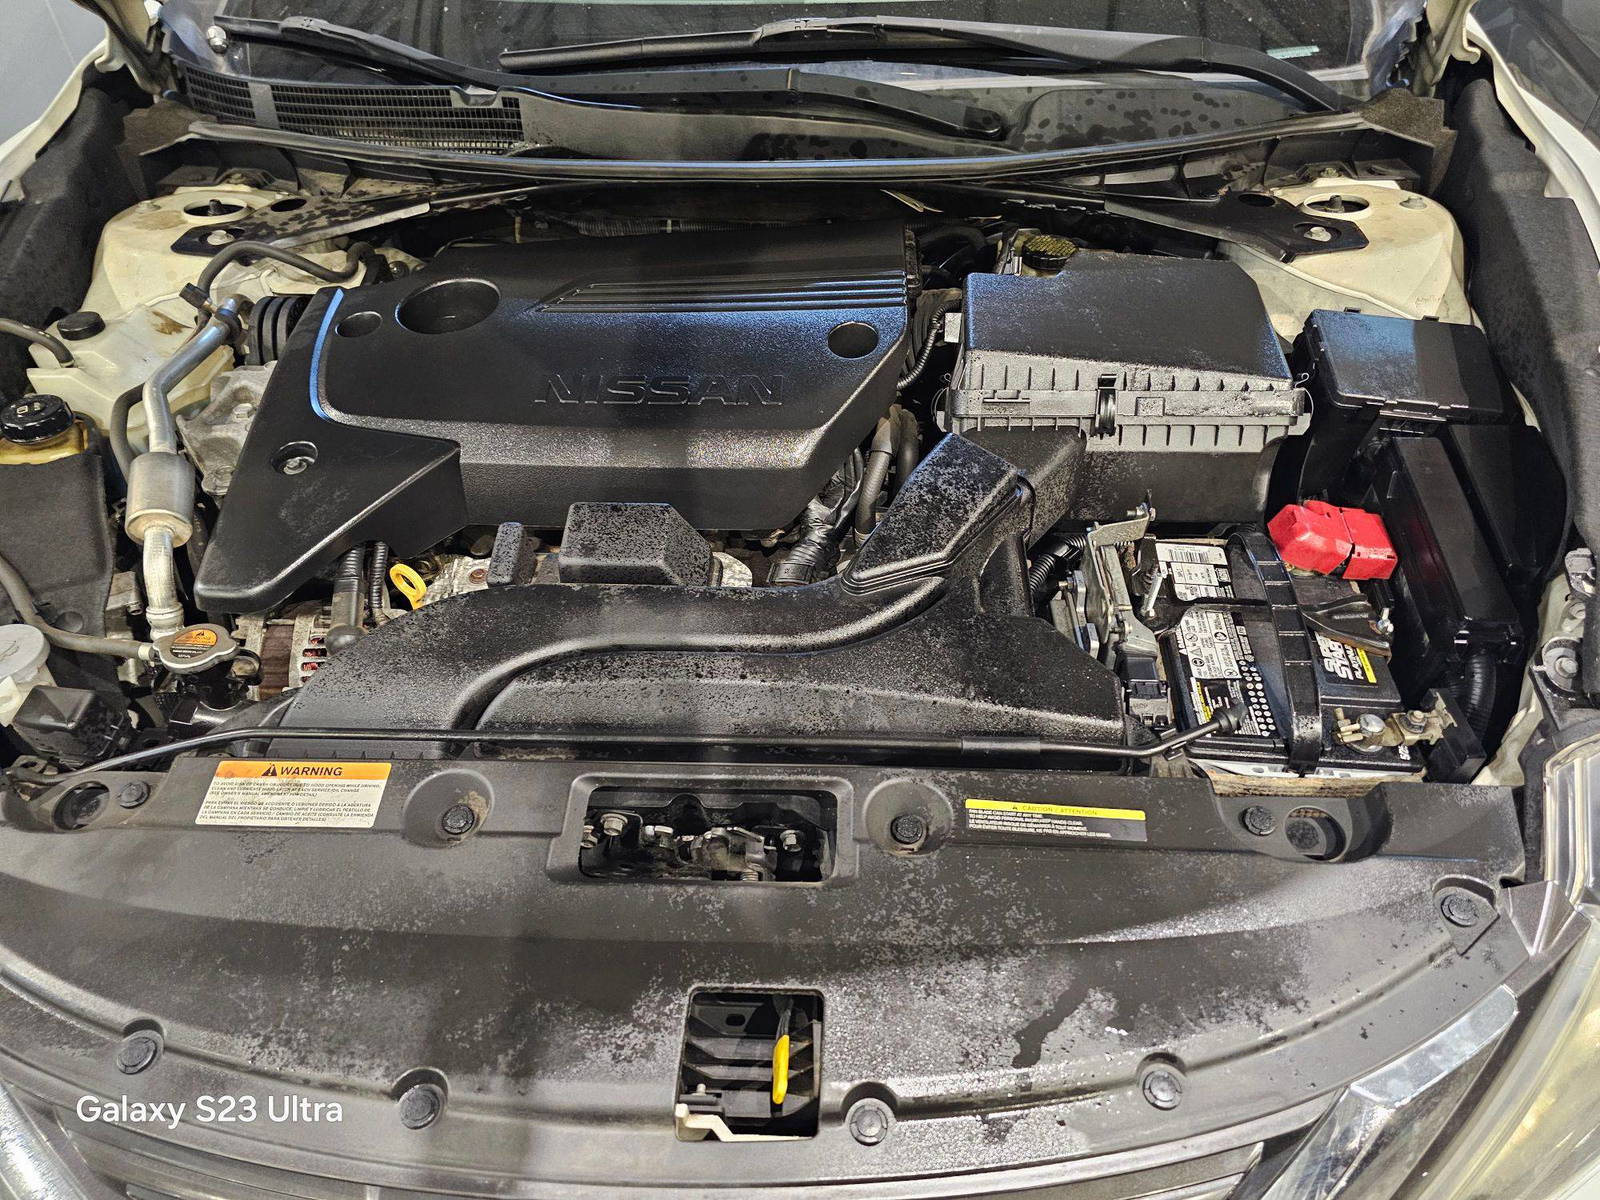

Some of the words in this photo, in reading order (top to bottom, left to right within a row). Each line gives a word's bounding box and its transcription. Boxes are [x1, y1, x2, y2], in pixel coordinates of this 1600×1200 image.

[535, 375, 783, 405] NISSAN
[280, 766, 343, 776] WARNING
[1060, 807, 1097, 815] ATTENTION
